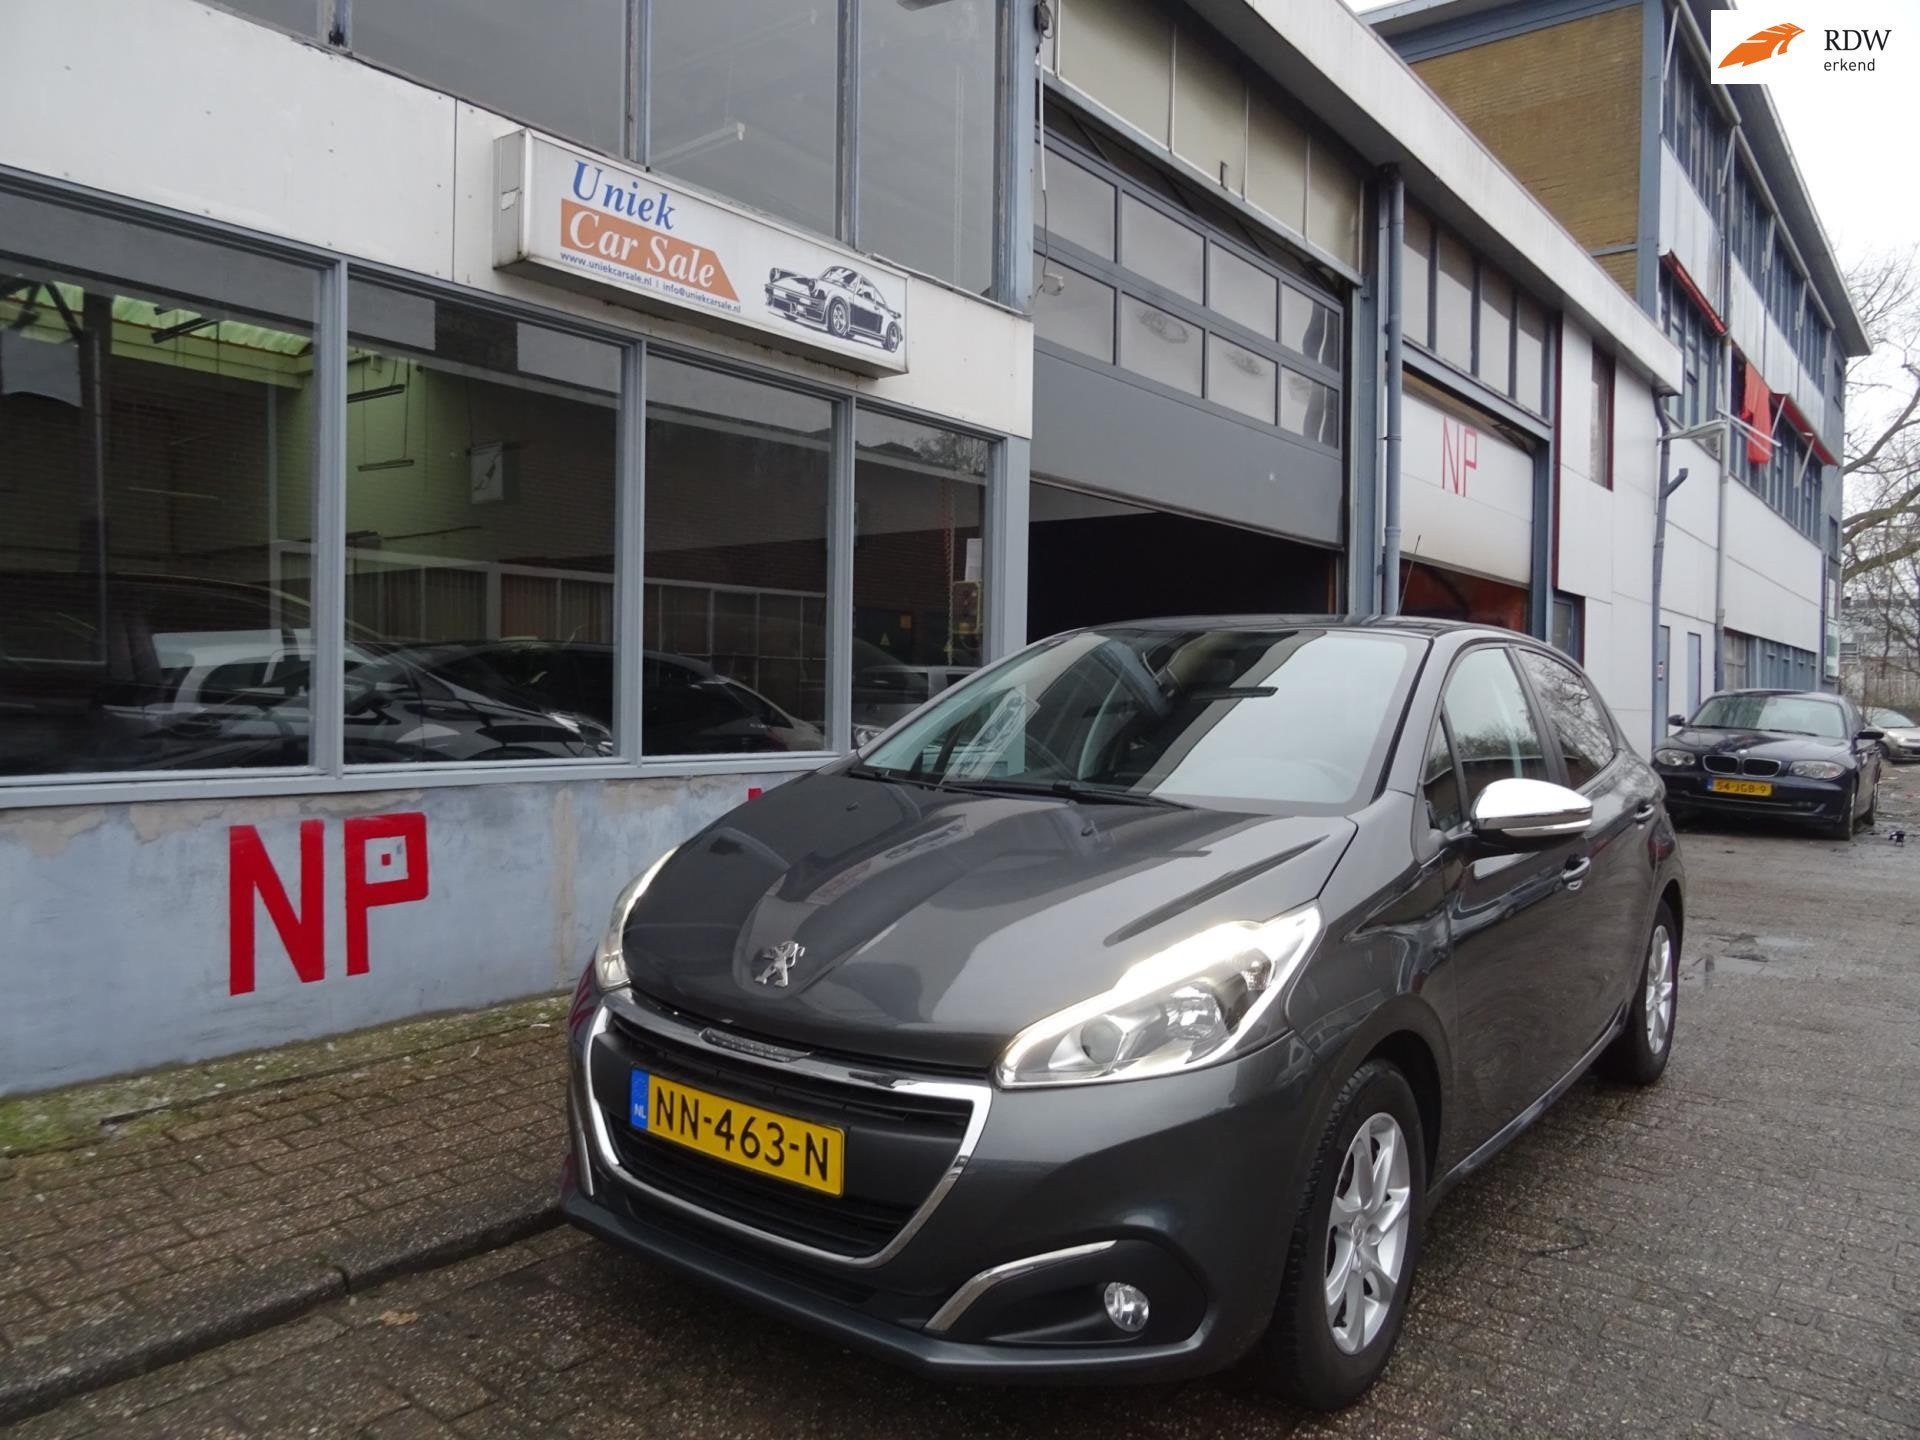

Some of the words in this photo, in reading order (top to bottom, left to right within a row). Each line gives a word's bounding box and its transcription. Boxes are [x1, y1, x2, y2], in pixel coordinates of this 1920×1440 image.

[572, 159, 676, 230] Uniek
[559, 251, 653, 287] www.uniekcarsale.nl
[662, 283, 742, 314] info@uniekcarsale.nl
[568, 210, 639, 261] Car
[645, 237, 716, 288] Sale
[1441, 414, 1478, 498] NP
[229, 811, 429, 996] NP
[634, 1103, 647, 1119] NL
[656, 1085, 829, 1182] NN-463-N
